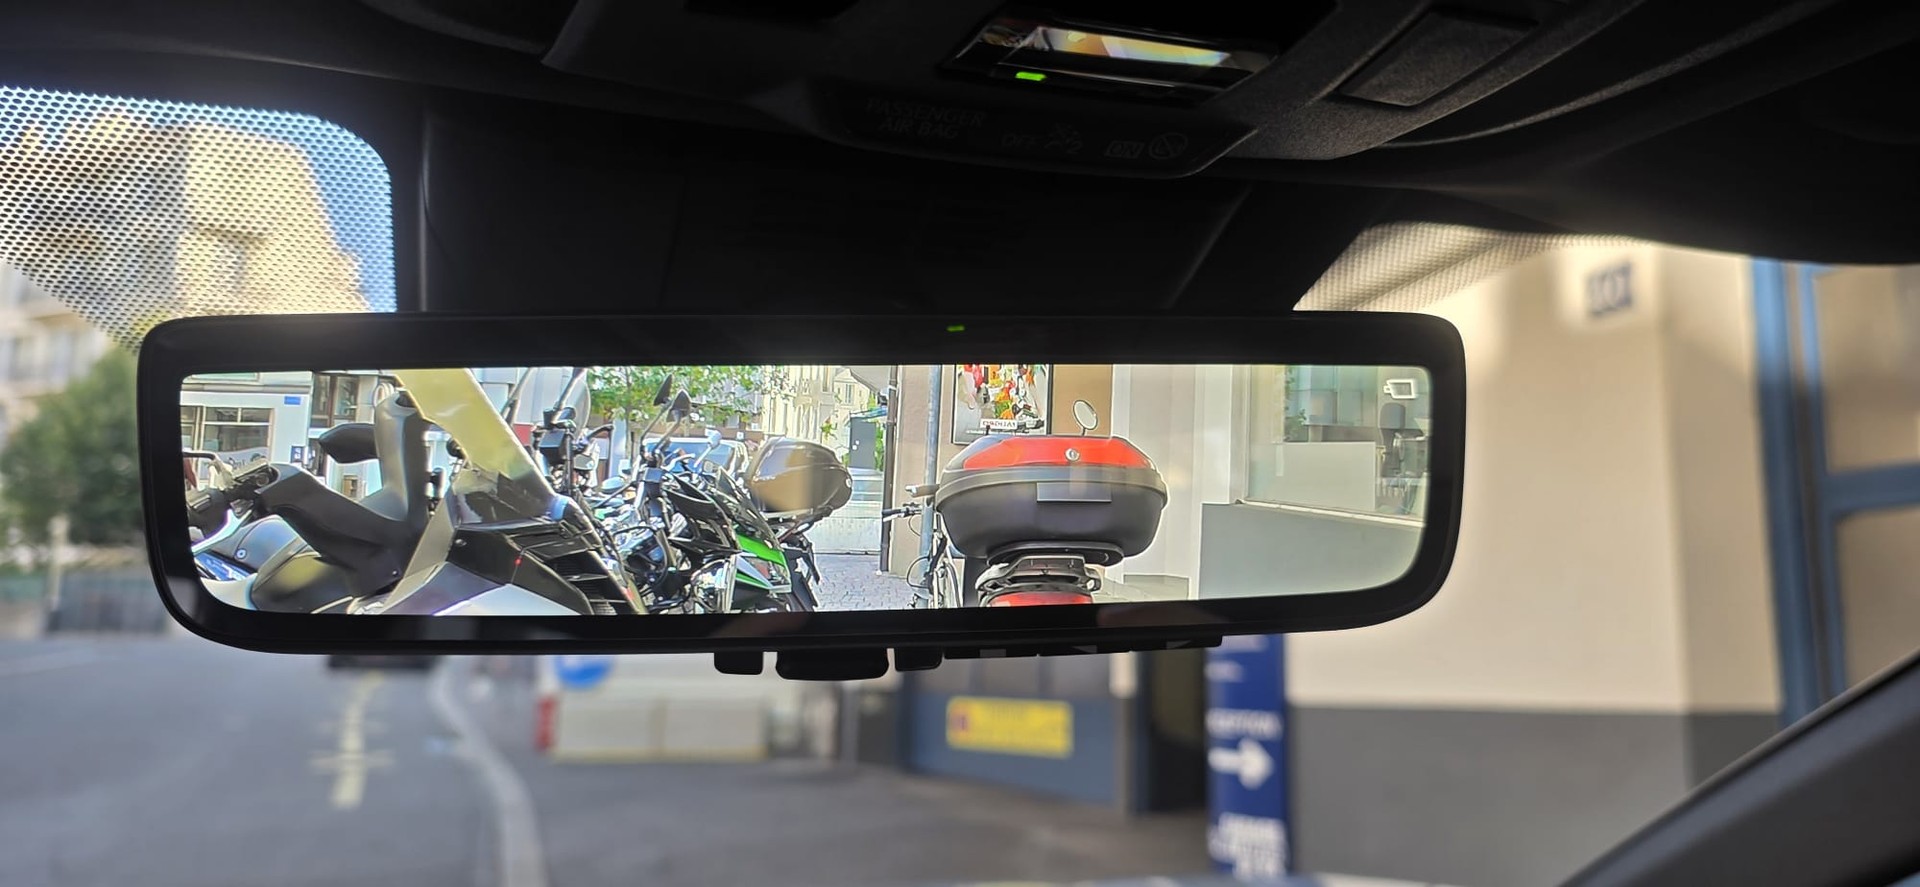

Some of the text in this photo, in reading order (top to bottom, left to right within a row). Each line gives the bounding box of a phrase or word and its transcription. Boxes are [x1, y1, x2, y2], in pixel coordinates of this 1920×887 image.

[865, 97, 987, 127] PASSENGER
[878, 117, 961, 139] AIR BAG
[1001, 132, 1038, 150] OFF
[1107, 142, 1142, 158] ON
